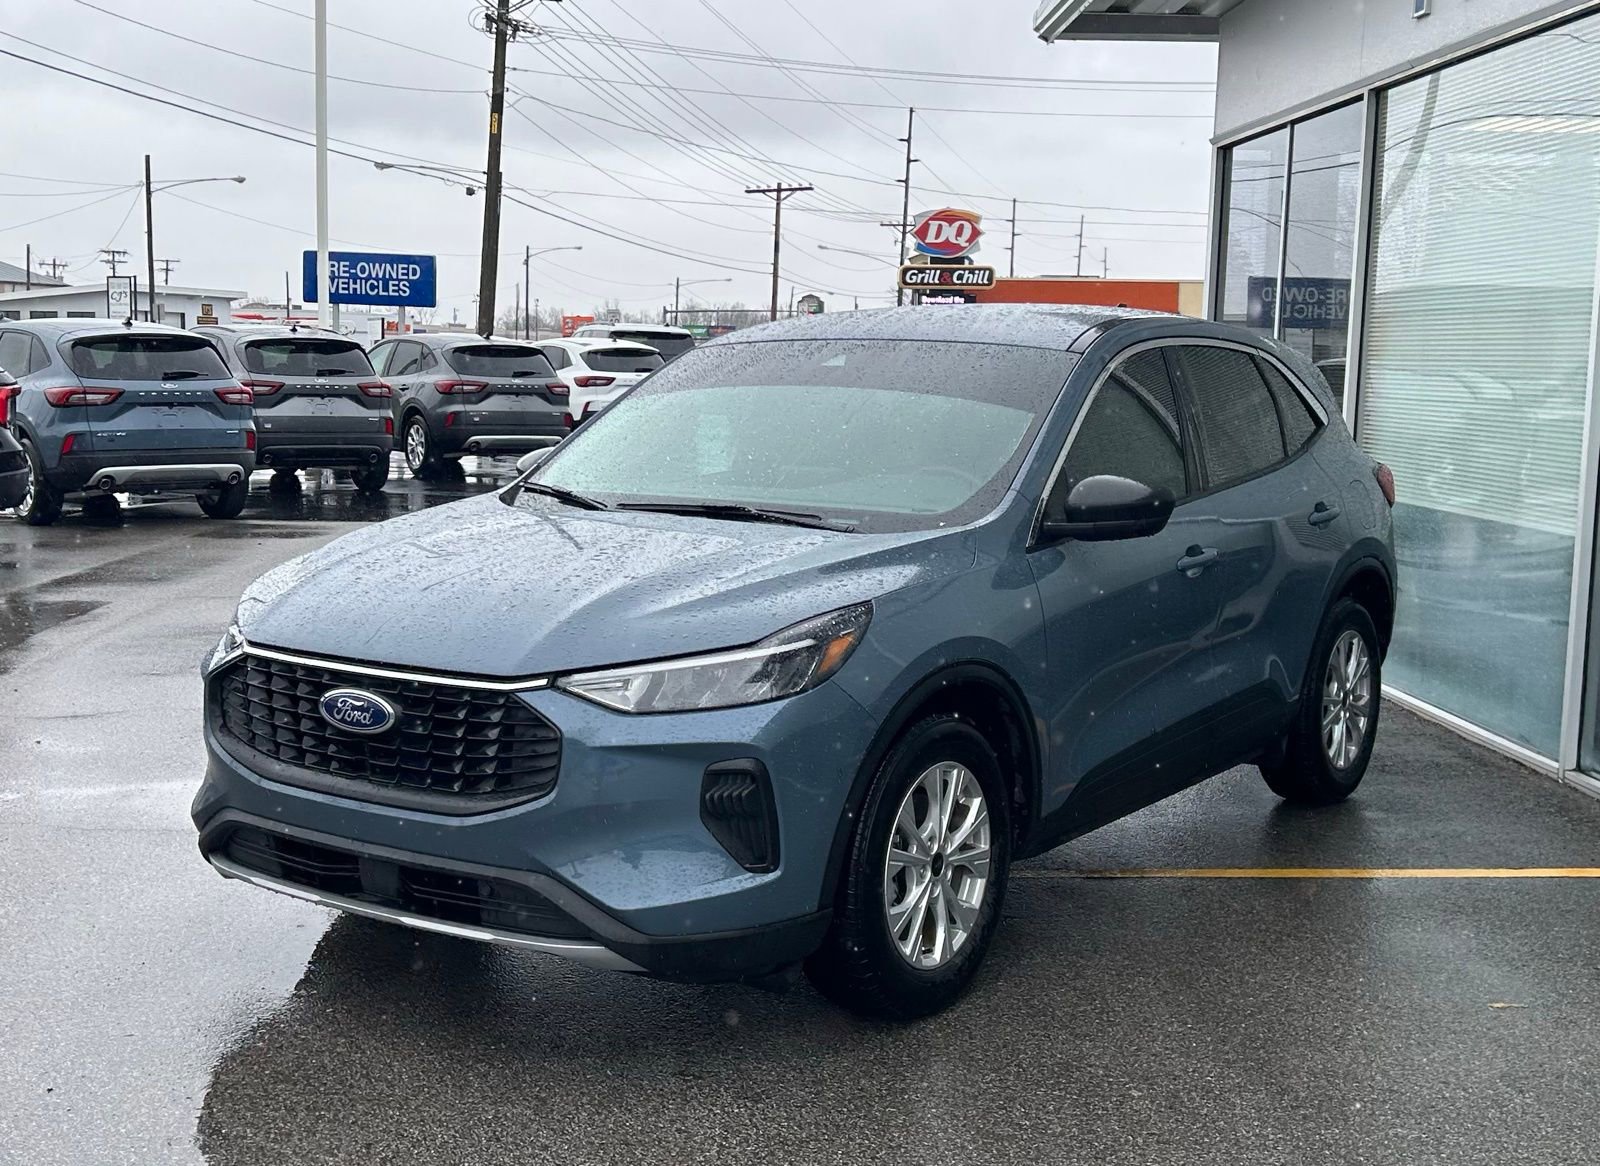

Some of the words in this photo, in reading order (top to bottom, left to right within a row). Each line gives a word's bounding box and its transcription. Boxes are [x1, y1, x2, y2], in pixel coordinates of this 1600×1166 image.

[925, 220, 972, 247] DQ
[328, 261, 421, 280] RE-OWNED
[906, 269, 940, 284] Grill
[941, 272, 951, 283] &
[953, 269, 989, 284] Chill
[328, 278, 410, 296] VEHICLES
[333, 697, 374, 724] Ford
